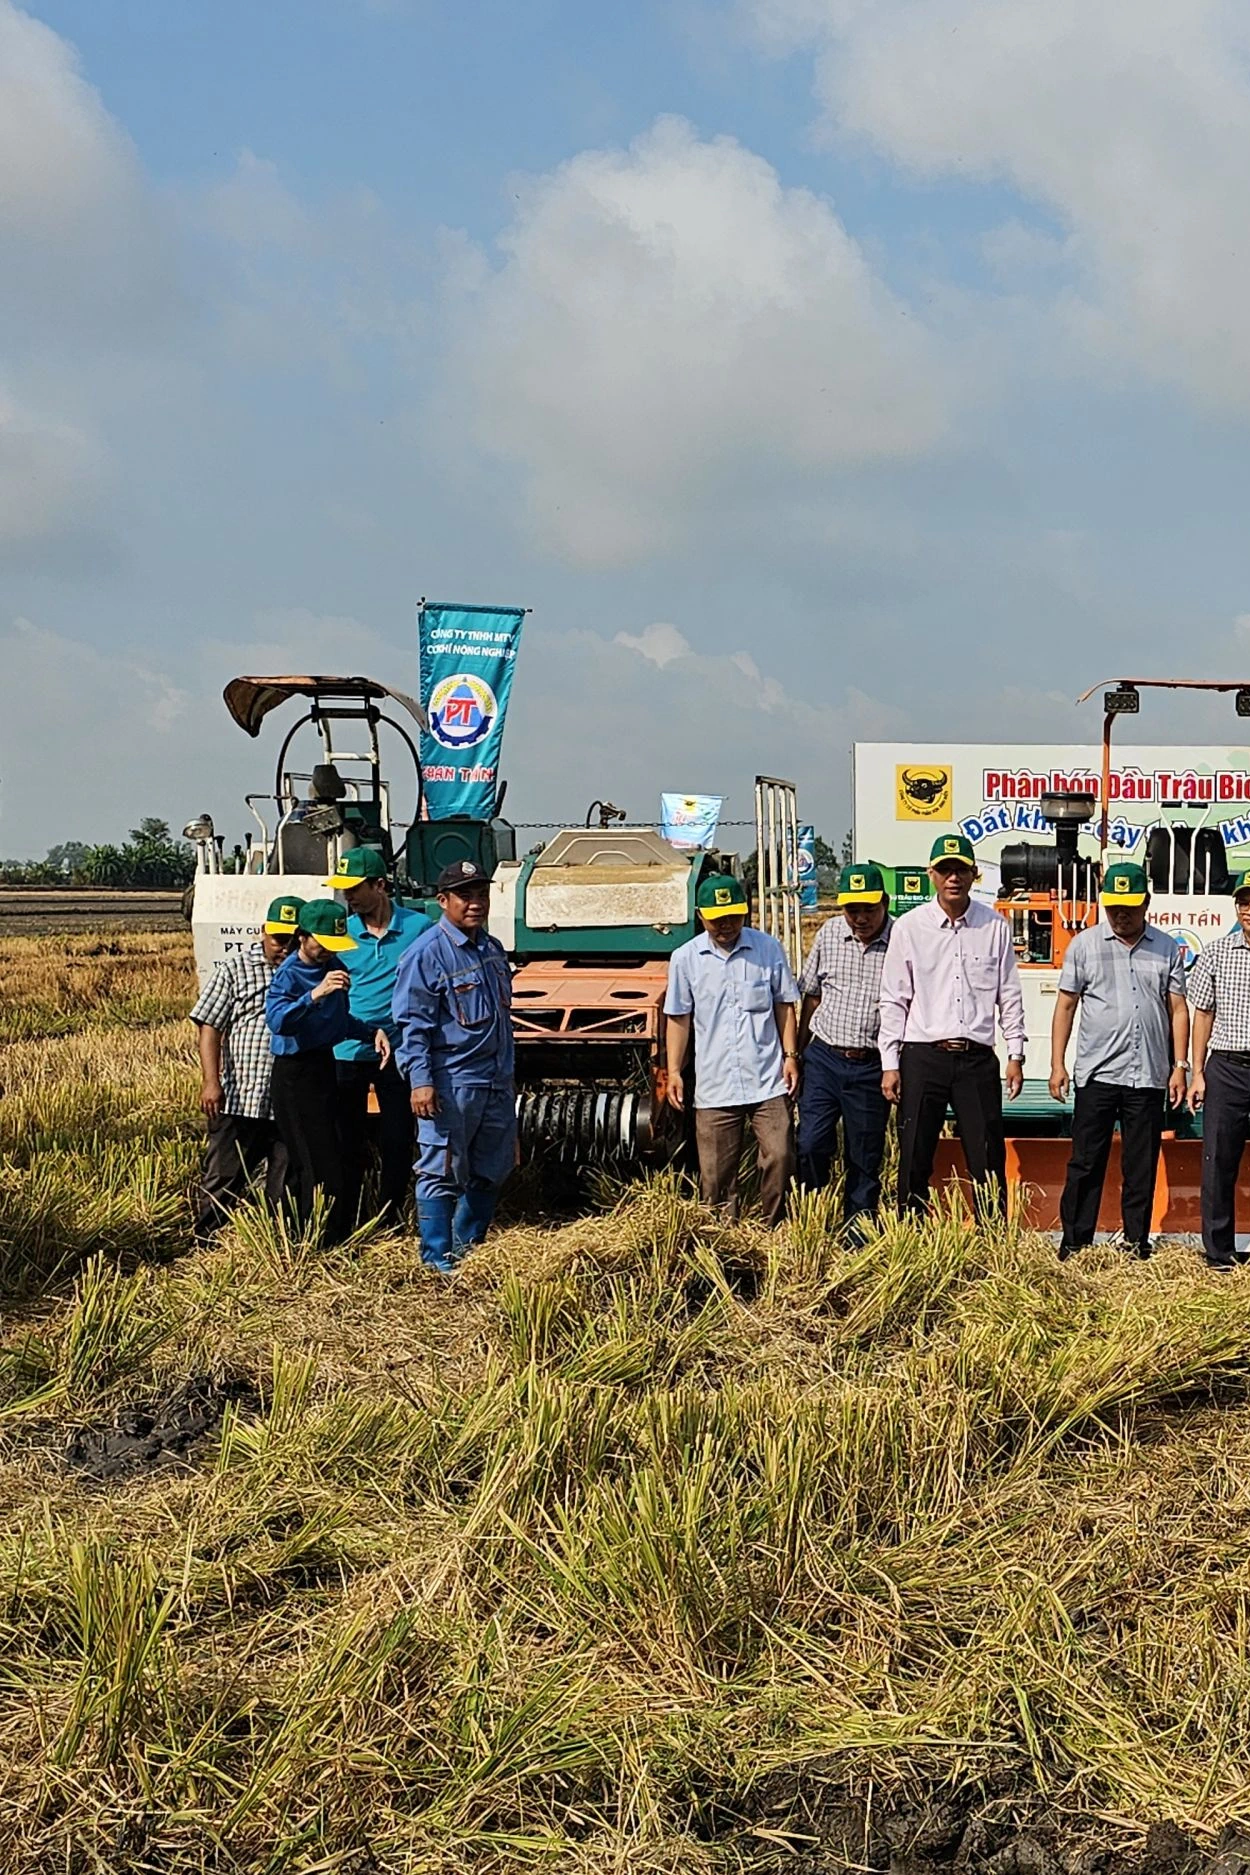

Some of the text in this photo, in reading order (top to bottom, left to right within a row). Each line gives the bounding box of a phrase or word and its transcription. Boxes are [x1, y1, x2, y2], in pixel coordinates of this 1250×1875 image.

[455, 629, 467, 640] TY
[468, 631, 493, 641] TNHH
[445, 698, 477, 724] PT
[986, 771, 1047, 798] Phân
[1158, 773, 1212, 799] Trâu
[963, 805, 1010, 842] Đất
[1149, 908, 1221, 926] HAN TẤN
[246, 927, 260, 935] CU
[224, 942, 244, 953] PT
